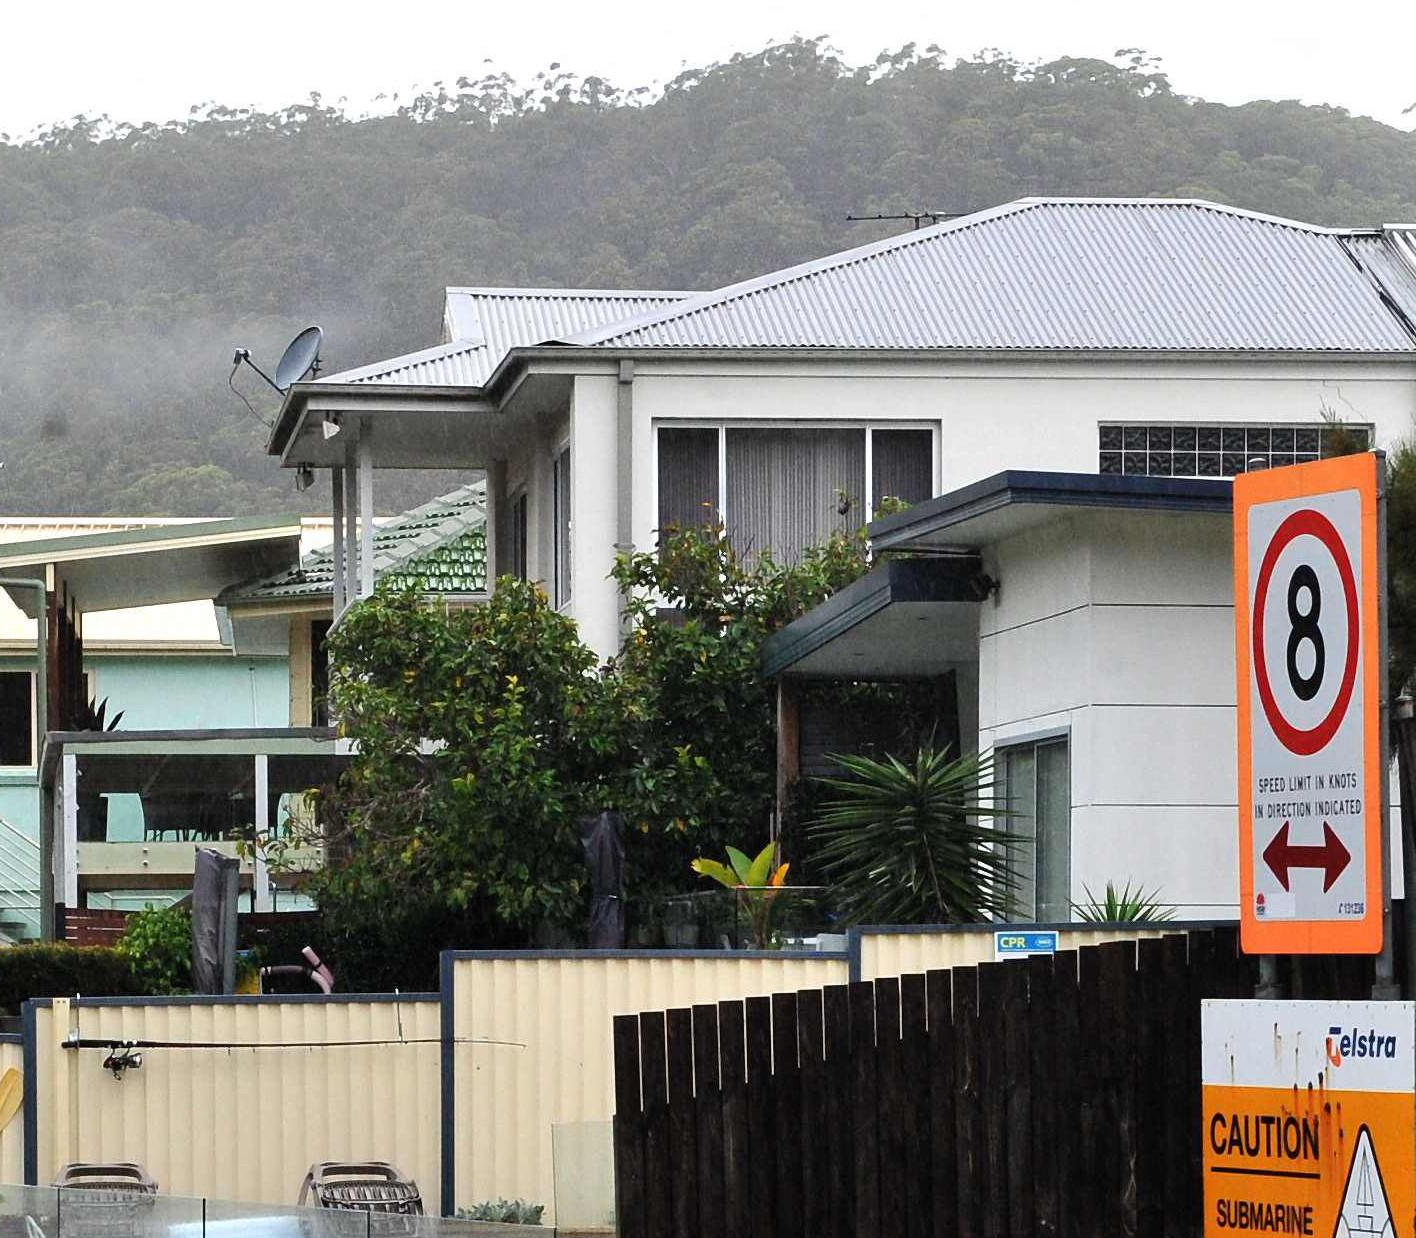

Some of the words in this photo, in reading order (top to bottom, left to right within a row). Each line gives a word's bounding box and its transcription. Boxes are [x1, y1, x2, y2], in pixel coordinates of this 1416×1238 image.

[1287, 564, 1326, 702] 8
[1259, 777, 1285, 793] SPEED
[1289, 775, 1311, 791] LIMIT
[1315, 775, 1324, 790] IN
[1329, 773, 1357, 789] KNOTS
[1255, 804, 1264, 818] IN
[1267, 802, 1311, 818] DIRECTION
[1315, 799, 1362, 815] INDICATED
[999, 936, 1026, 948] CPR
[1325, 1026, 1397, 1067] Telstra
[1210, 1112, 1319, 1160] CAUTION
[1216, 1198, 1314, 1236] SUBMARINE
